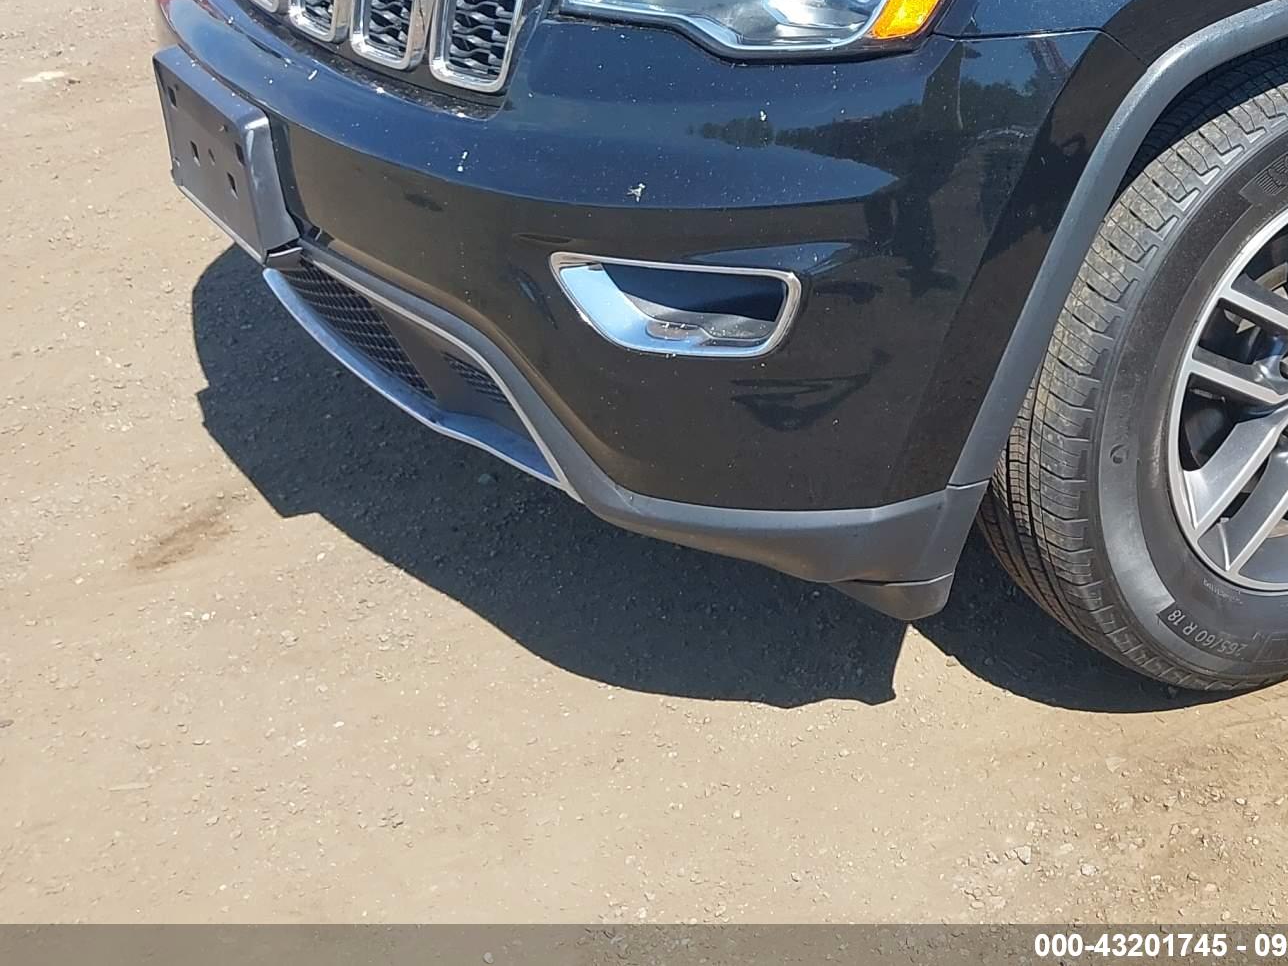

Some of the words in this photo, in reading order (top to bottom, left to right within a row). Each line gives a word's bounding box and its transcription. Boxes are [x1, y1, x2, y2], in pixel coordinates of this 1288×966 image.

[1167, 609, 1186, 627] 18
[1182, 622, 1198, 636] R
[1194, 630, 1249, 657] 265/60
